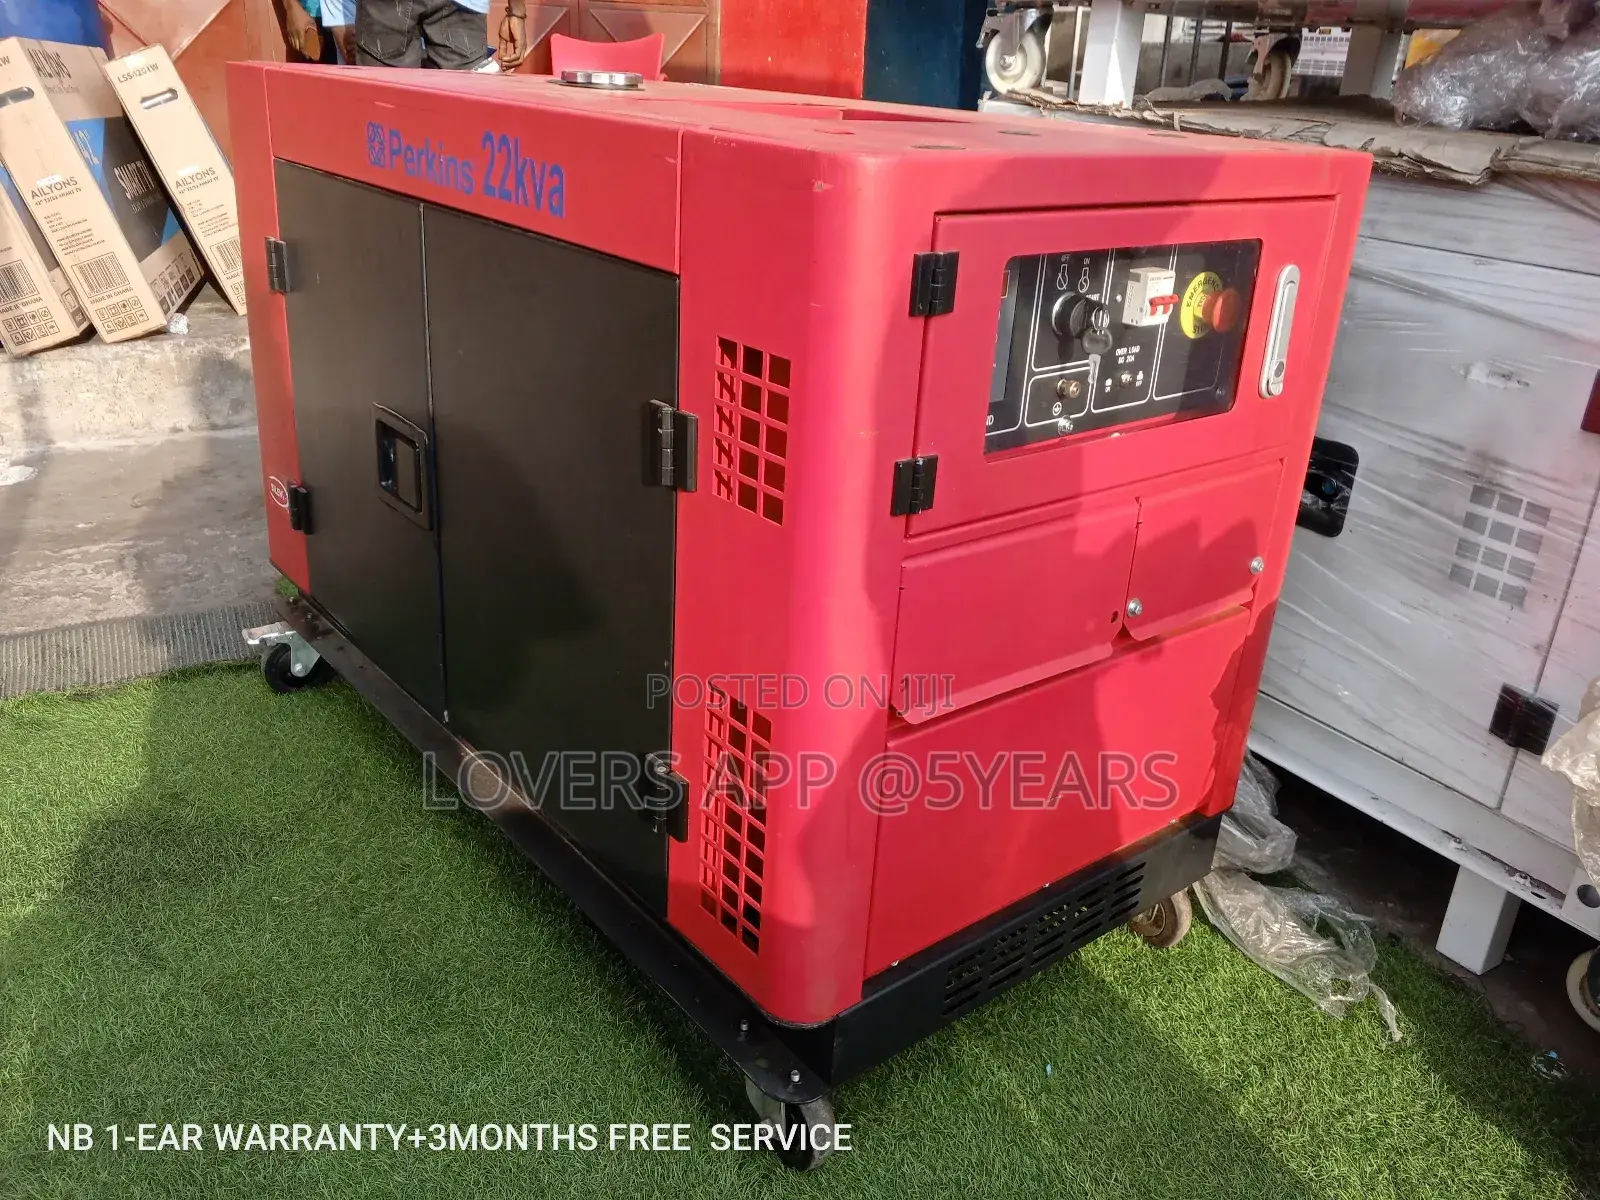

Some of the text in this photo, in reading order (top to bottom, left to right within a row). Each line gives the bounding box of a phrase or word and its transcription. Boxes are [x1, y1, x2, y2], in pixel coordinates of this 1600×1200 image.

[114, 162, 146, 200] SMART
[175, 167, 216, 189] AILYONS
[388, 128, 565, 219] Perkins 22kva
[31, 176, 78, 200] AILYONS
[21, 297, 43, 307] GHANA
[90, 297, 105, 305] MADE
[113, 287, 134, 297] GHANA
[1186, 276, 1220, 308] EMERGENC
[1116, 345, 1140, 356] OVER LOAD
